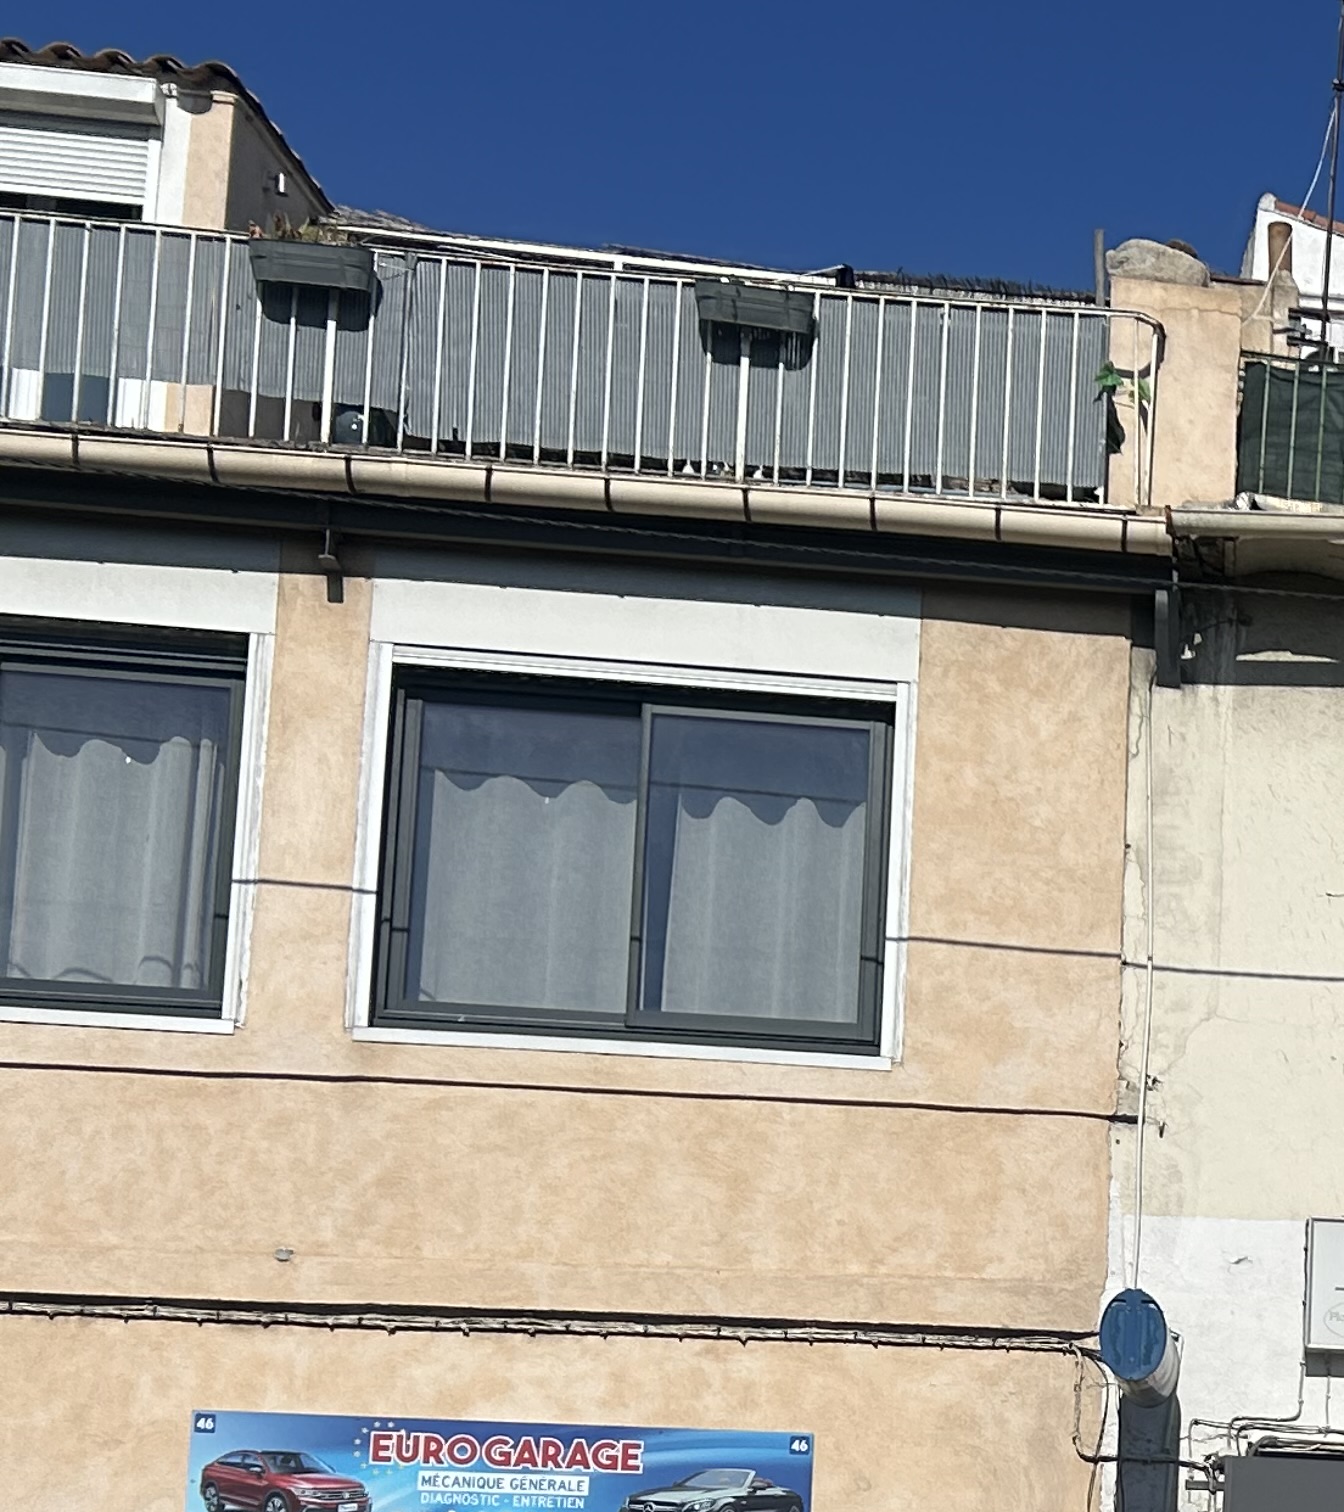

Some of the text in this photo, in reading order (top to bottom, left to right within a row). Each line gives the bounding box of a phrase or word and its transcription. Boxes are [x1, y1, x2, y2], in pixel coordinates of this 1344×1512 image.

[196, 1418, 214, 1430] 46
[790, 1440, 808, 1451] 46
[420, 1473, 586, 1493] MÉCANIQUE GÉNÉRALE
[420, 1493, 500, 1507] DIAGNOSTIC
[512, 1495, 585, 1509] ENTRETIEN
